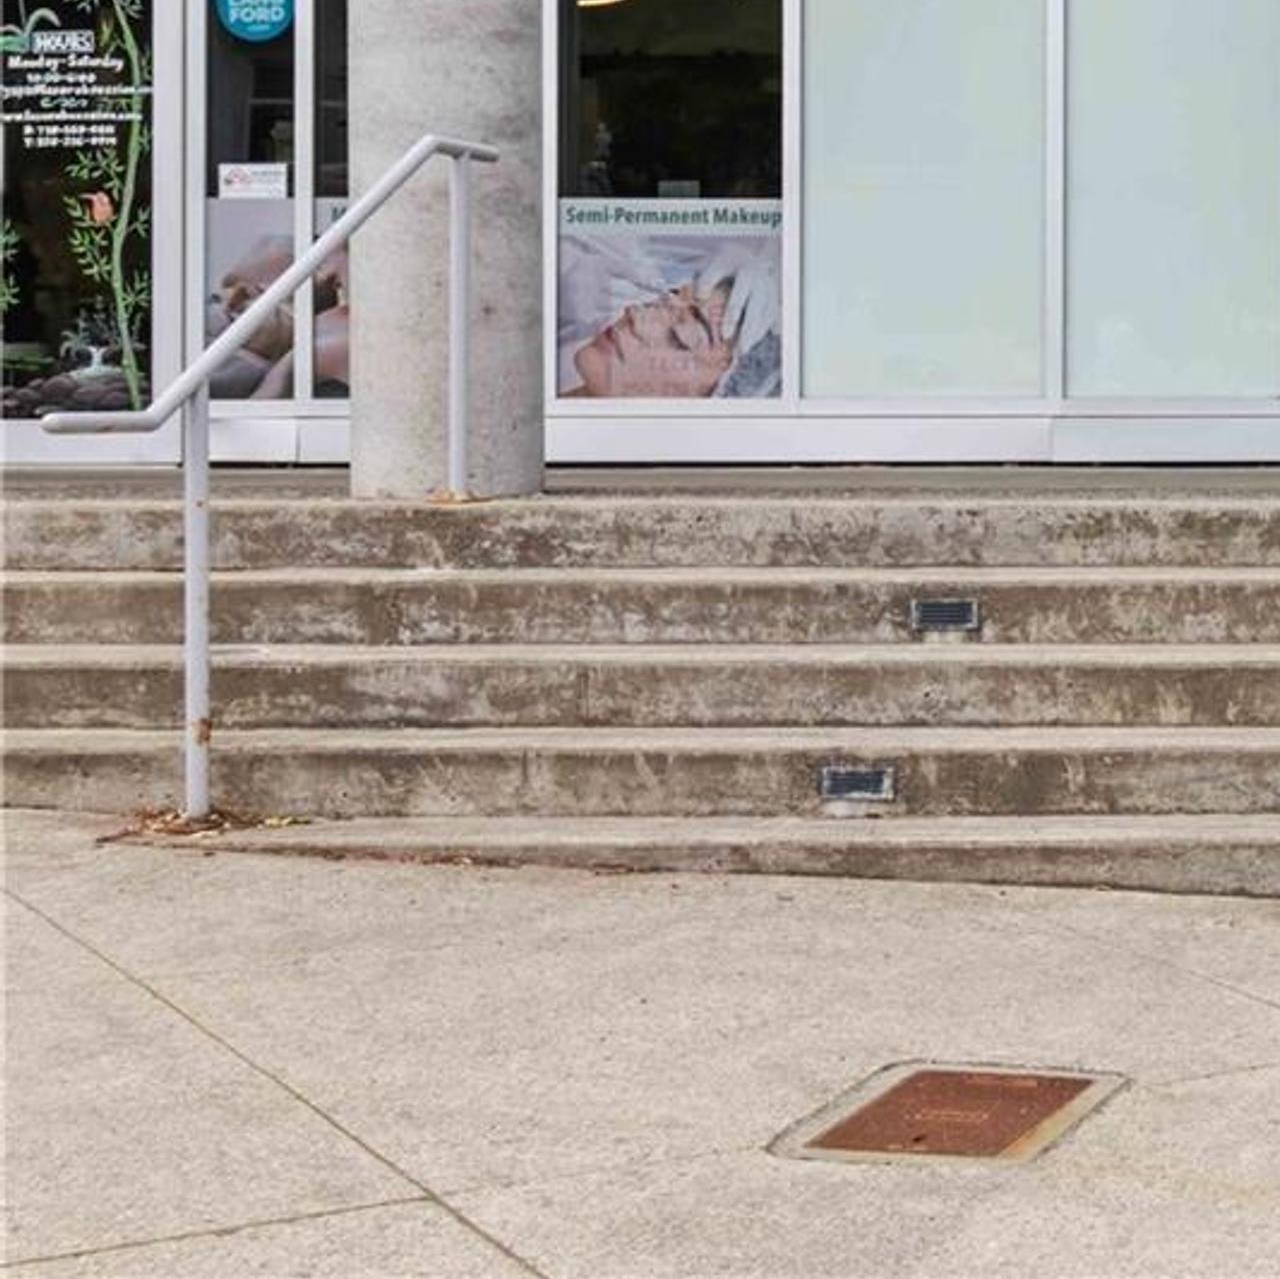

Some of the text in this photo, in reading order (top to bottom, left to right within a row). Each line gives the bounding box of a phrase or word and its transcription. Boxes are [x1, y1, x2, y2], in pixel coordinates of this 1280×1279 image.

[229, 6, 285, 23] FORD
[566, 208, 783, 228] Semi-Permanent Makeup
